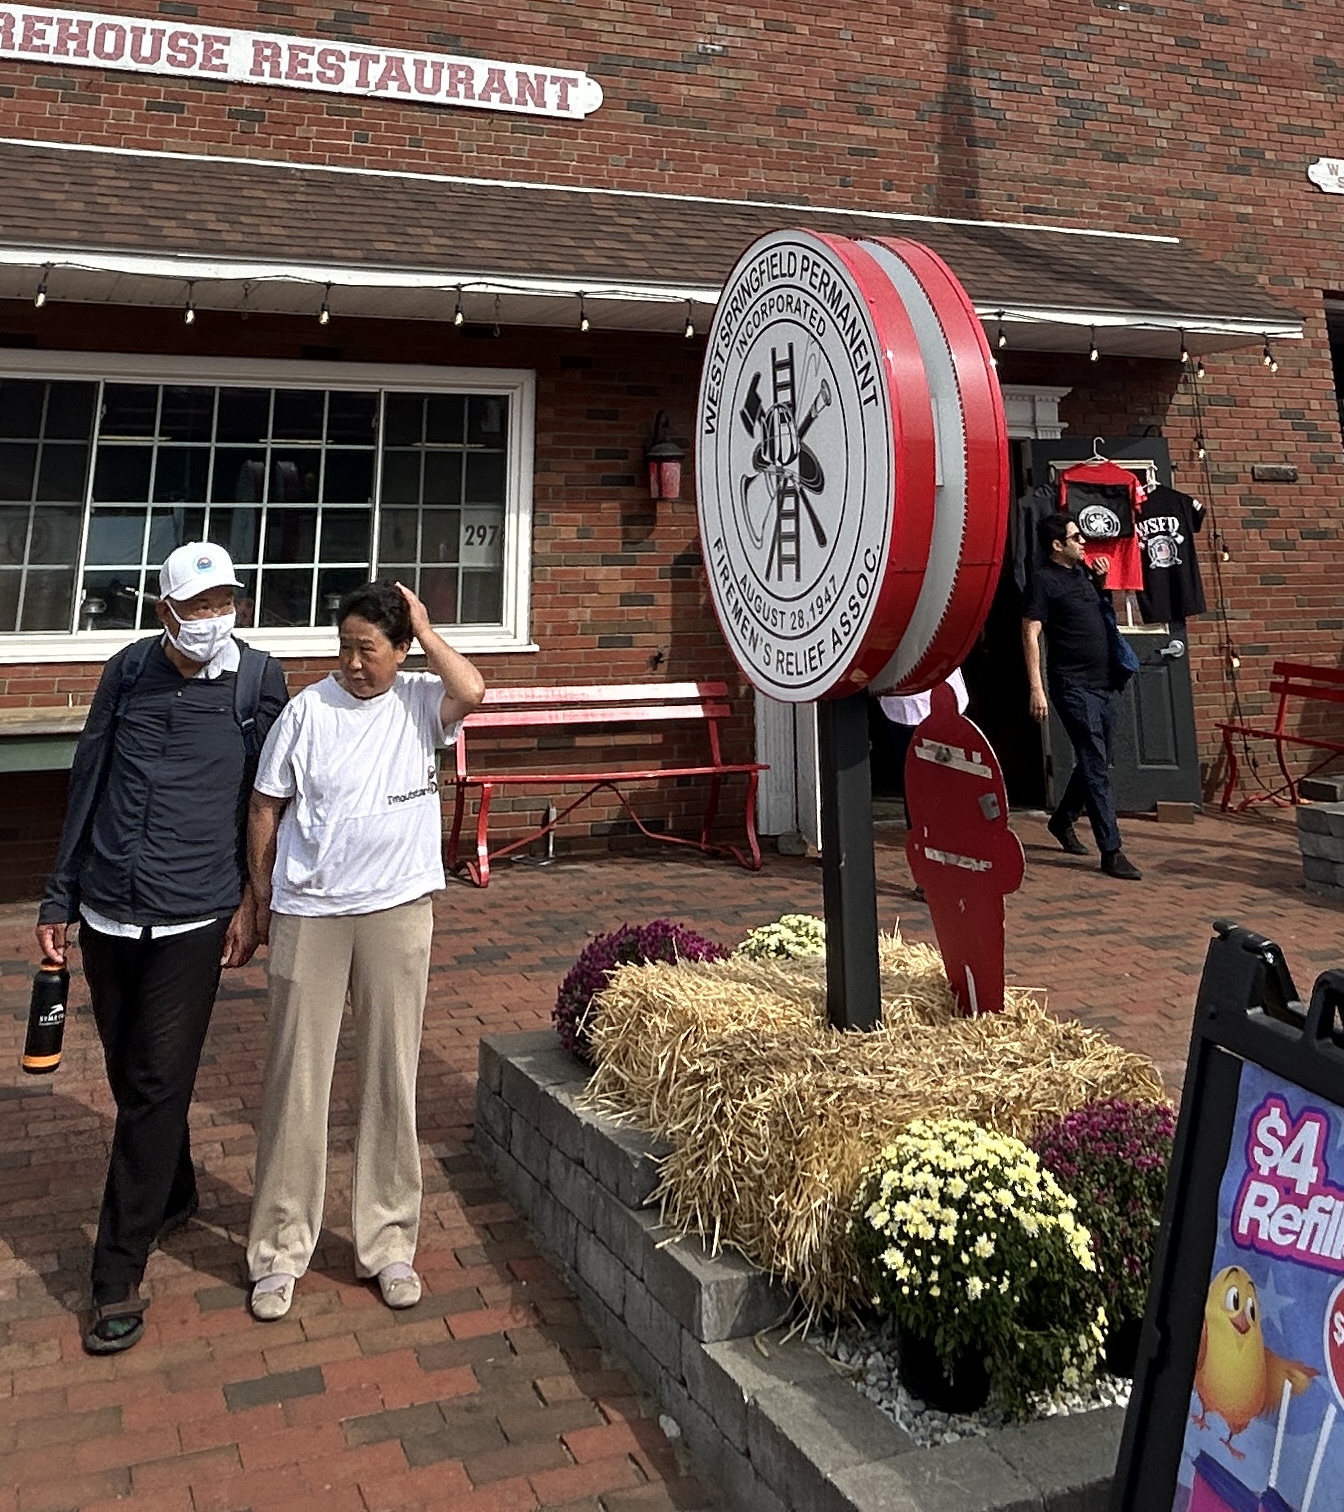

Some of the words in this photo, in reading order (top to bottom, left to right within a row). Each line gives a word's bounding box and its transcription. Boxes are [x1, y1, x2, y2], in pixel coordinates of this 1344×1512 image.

[249, 38, 580, 112] RESTAURANT
[704, 342, 726, 435] WEST
[720, 251, 797, 349] SPRINGFIELD
[799, 254, 879, 407] PERMANENT
[736, 294, 826, 359] INCORPORATED
[465, 524, 499, 546] 297
[713, 537, 772, 667] FIREMEN'S
[776, 639, 826, 676] RELIEF
[832, 544, 880, 654] ASSOC.
[740, 574, 786, 630] AUGUST
[1253, 1107, 1319, 1193] $4
